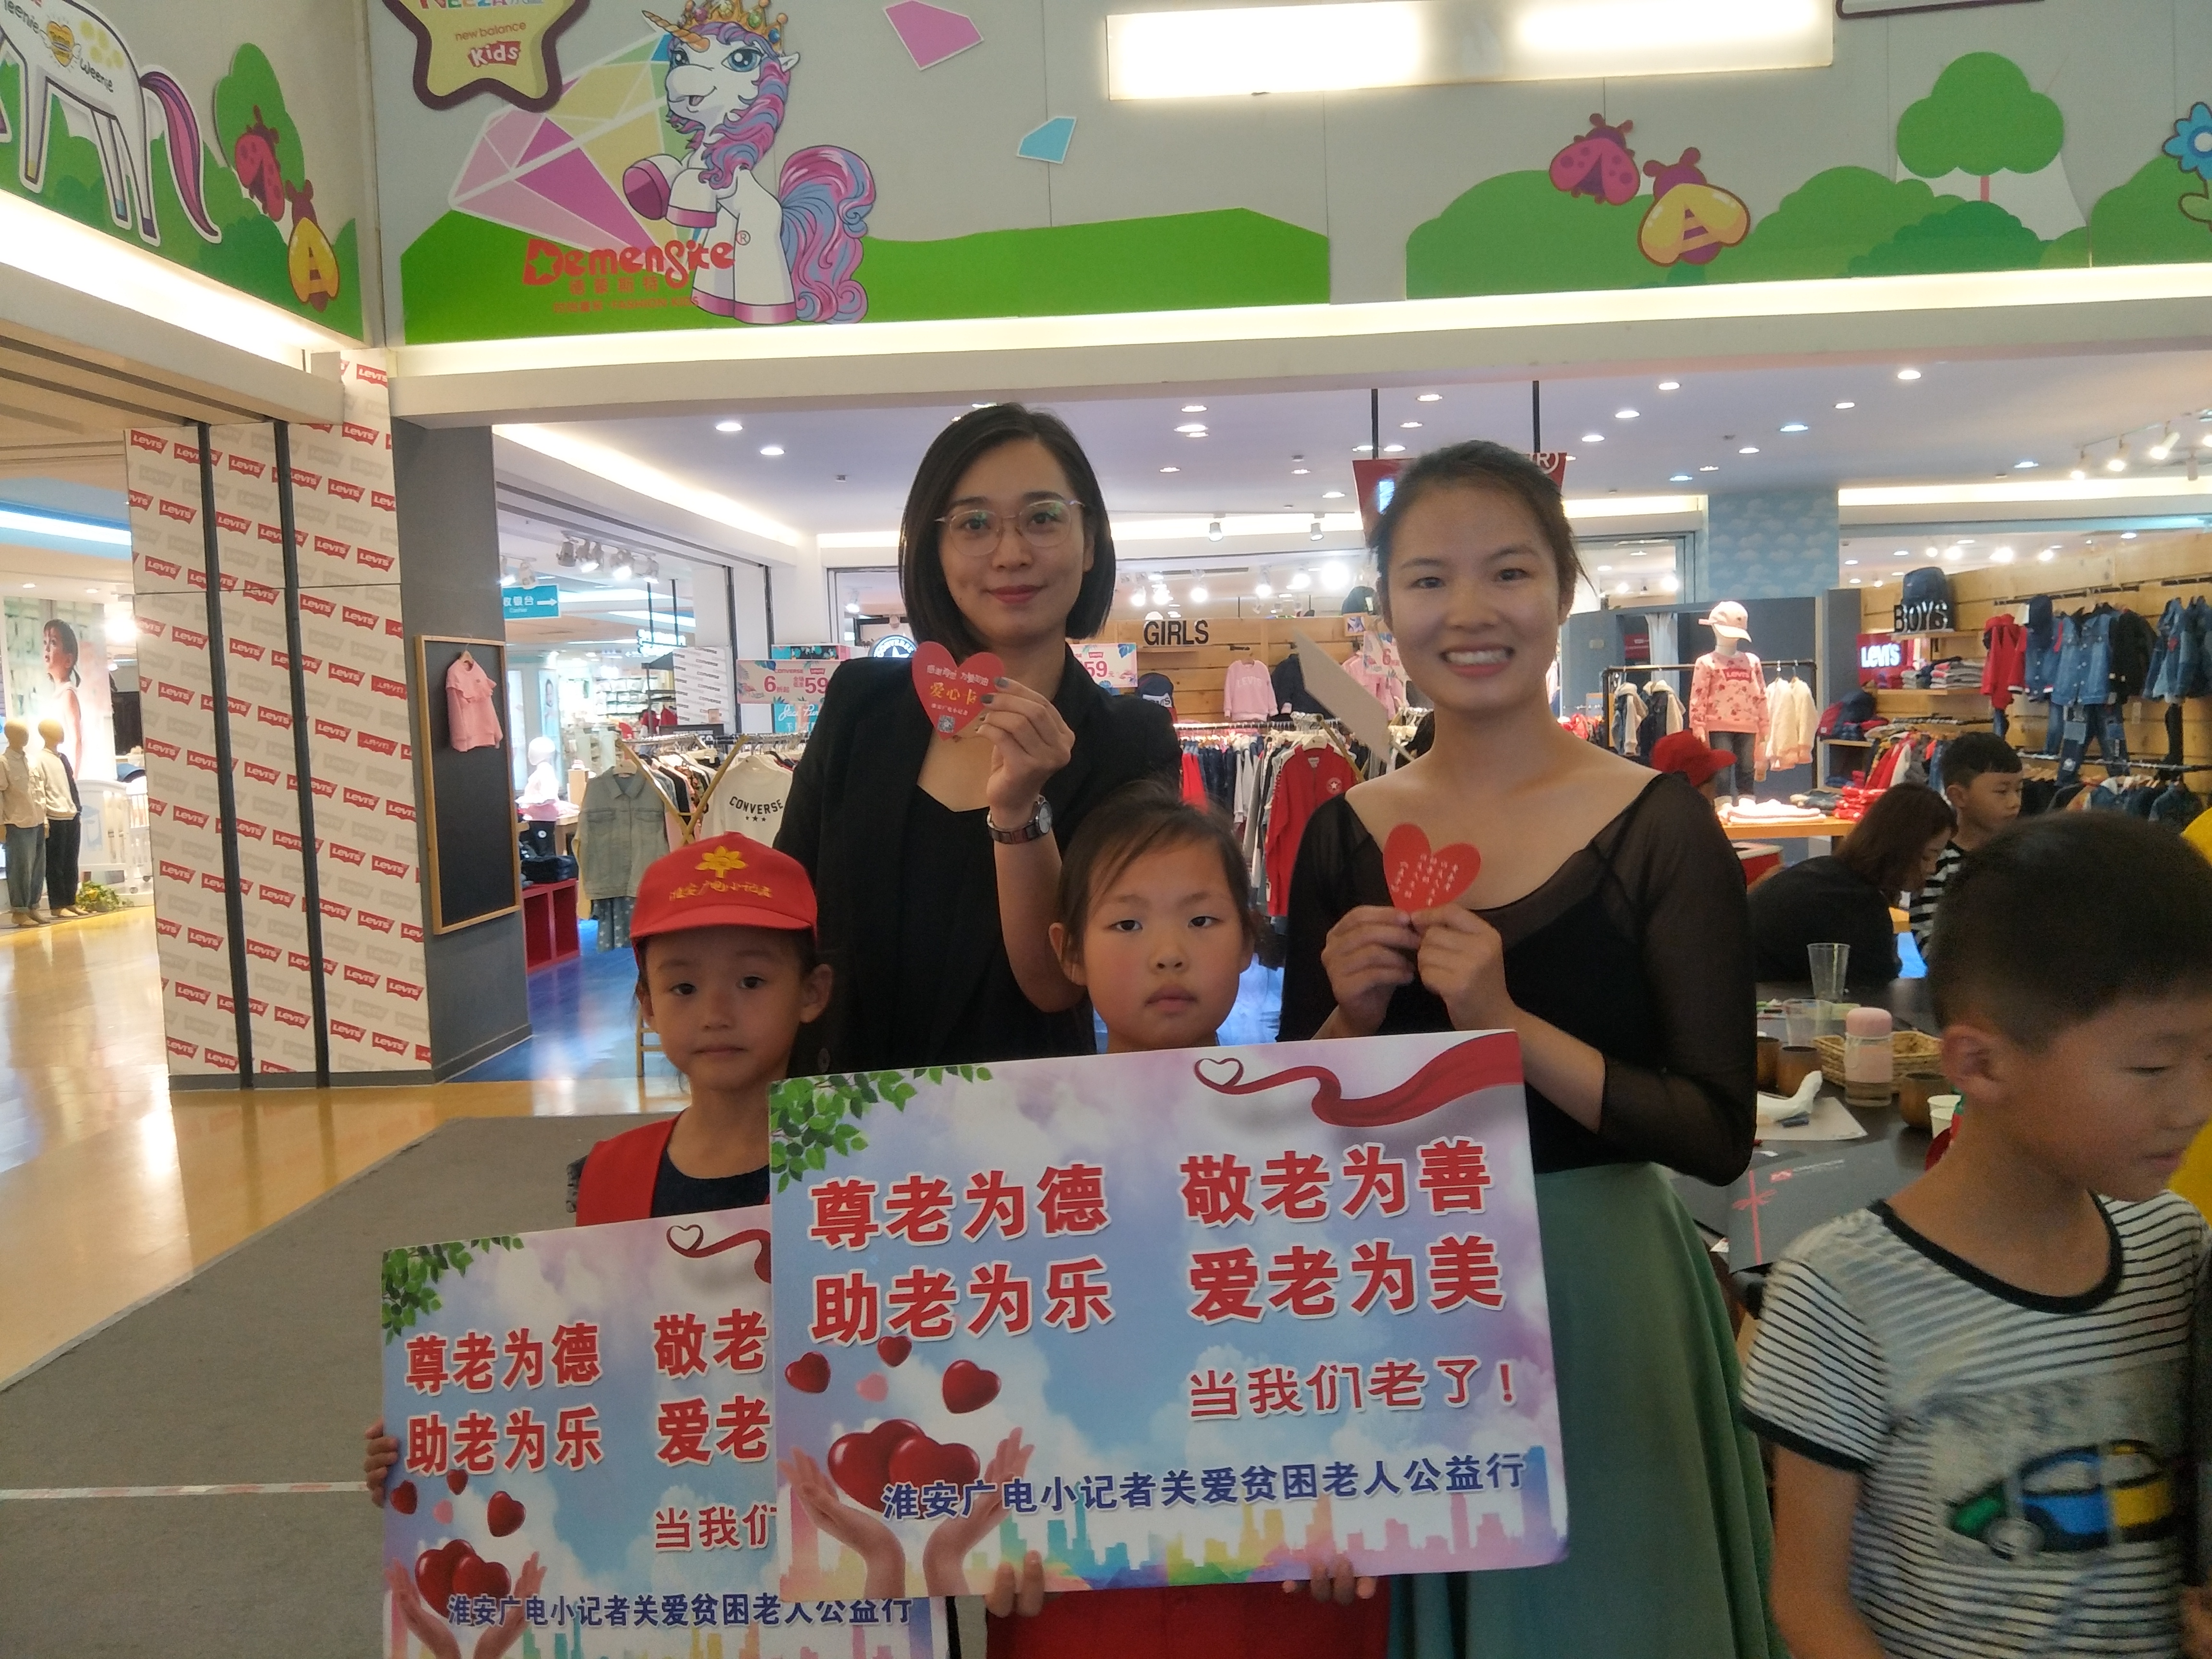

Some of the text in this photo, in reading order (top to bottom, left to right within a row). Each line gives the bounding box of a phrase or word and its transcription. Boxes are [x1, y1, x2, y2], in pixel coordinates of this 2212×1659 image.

[456, 22, 526, 41] new balance
[470, 44, 518, 67] Kids
[672, 296, 699, 307] KIDS
[1893, 600, 1949, 633] BOYS
[1143, 620, 1209, 645] GIRLS
[764, 676, 776, 692] 6
[805, 677, 828, 694] 59
[929, 682, 977, 705] 爱心卡
[729, 796, 783, 815] CONVERSE
[810, 1139, 1491, 1249] 尊老为德 敬老为善
[811, 1235, 1503, 1343] 助老为乐 爱老为美
[407, 1308, 767, 1393] 尊老为德 敬老
[407, 1395, 769, 1475] 助老为乐 爱老
[881, 1453, 1525, 1521] 淮安广电小记者关爱贫困老人公益行
